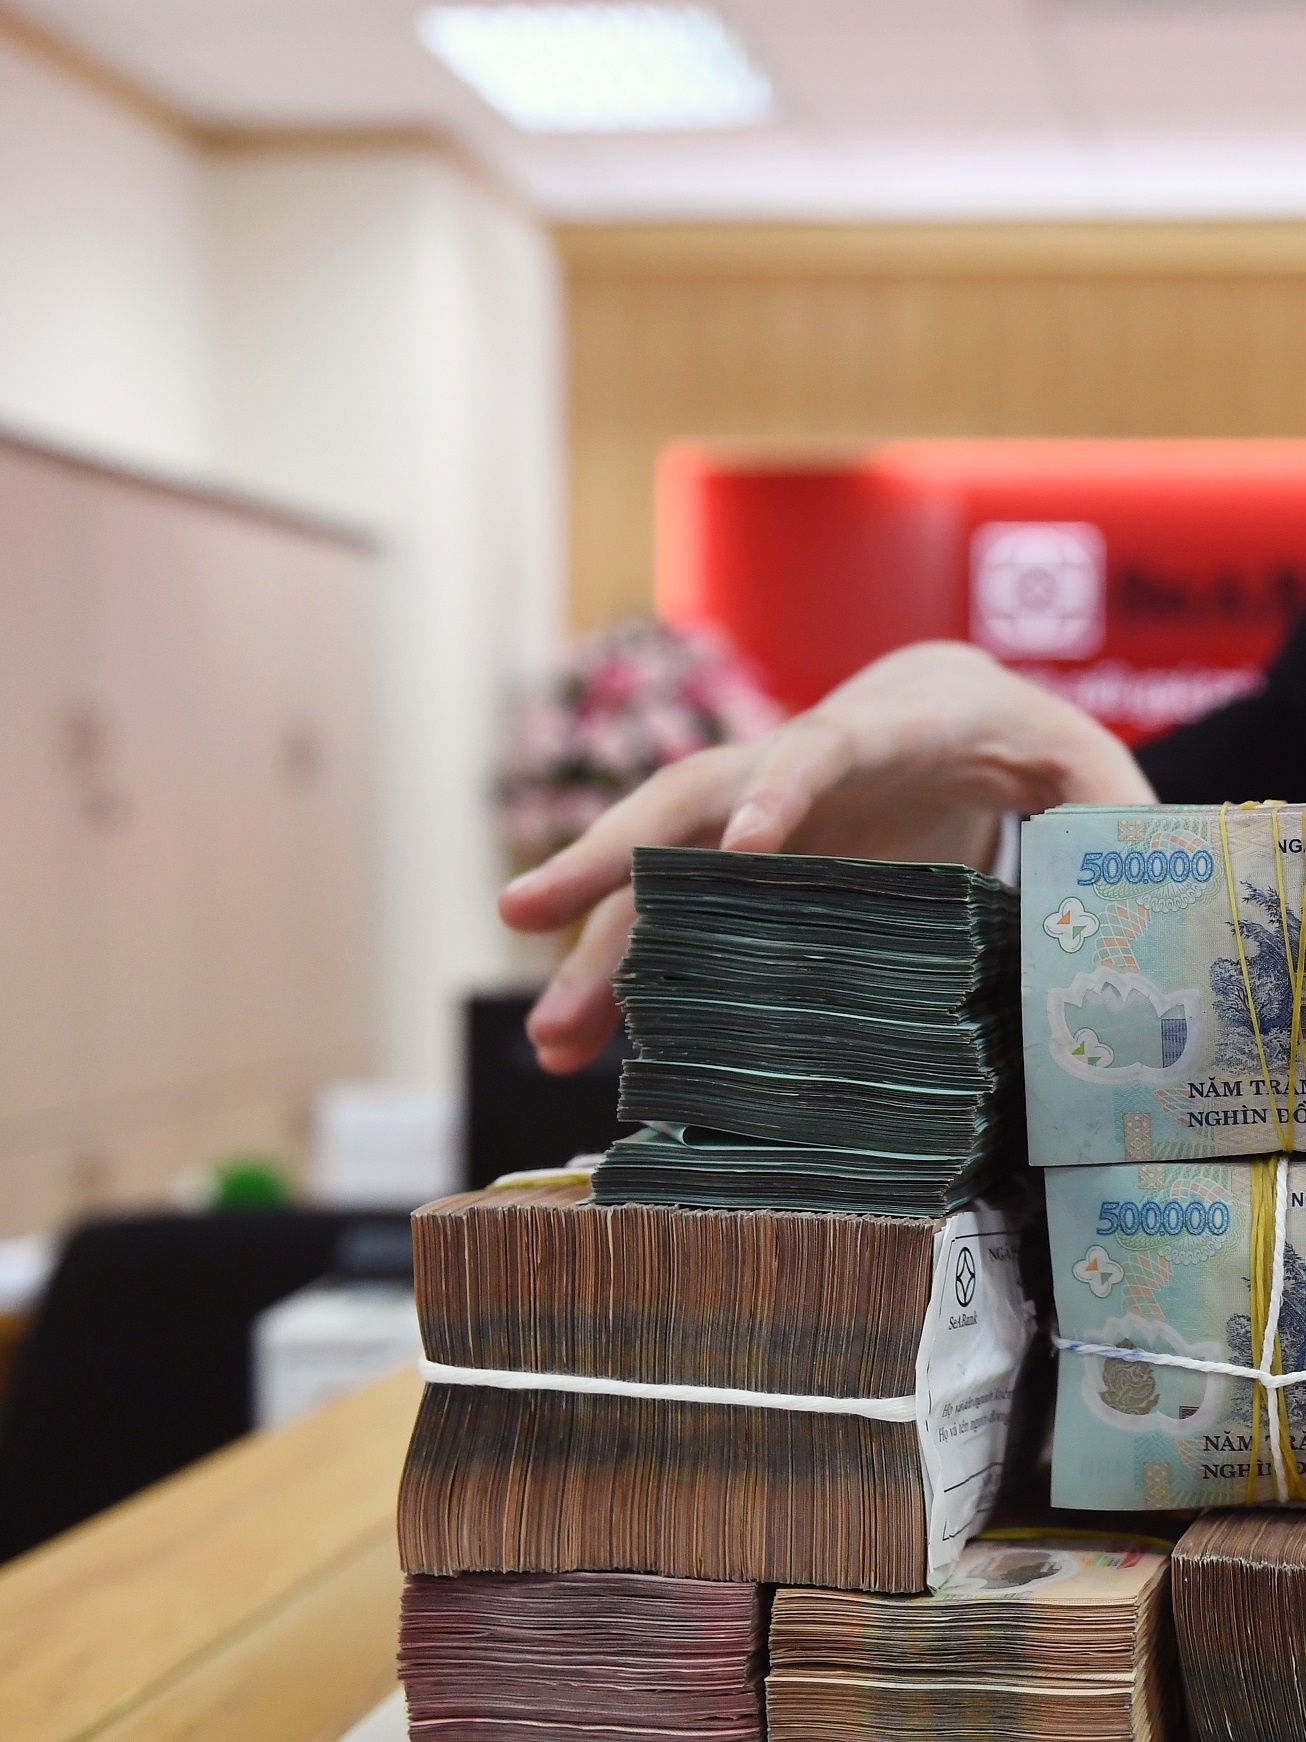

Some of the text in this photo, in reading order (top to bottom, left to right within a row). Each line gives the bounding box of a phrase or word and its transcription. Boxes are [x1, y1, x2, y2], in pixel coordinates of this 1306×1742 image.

[1077, 850, 1214, 887] 500.000
[1187, 1077, 1243, 1098] NĂM
[1187, 1105, 1268, 1127] NGHÌN
[1096, 1201, 1230, 1236] 500.000
